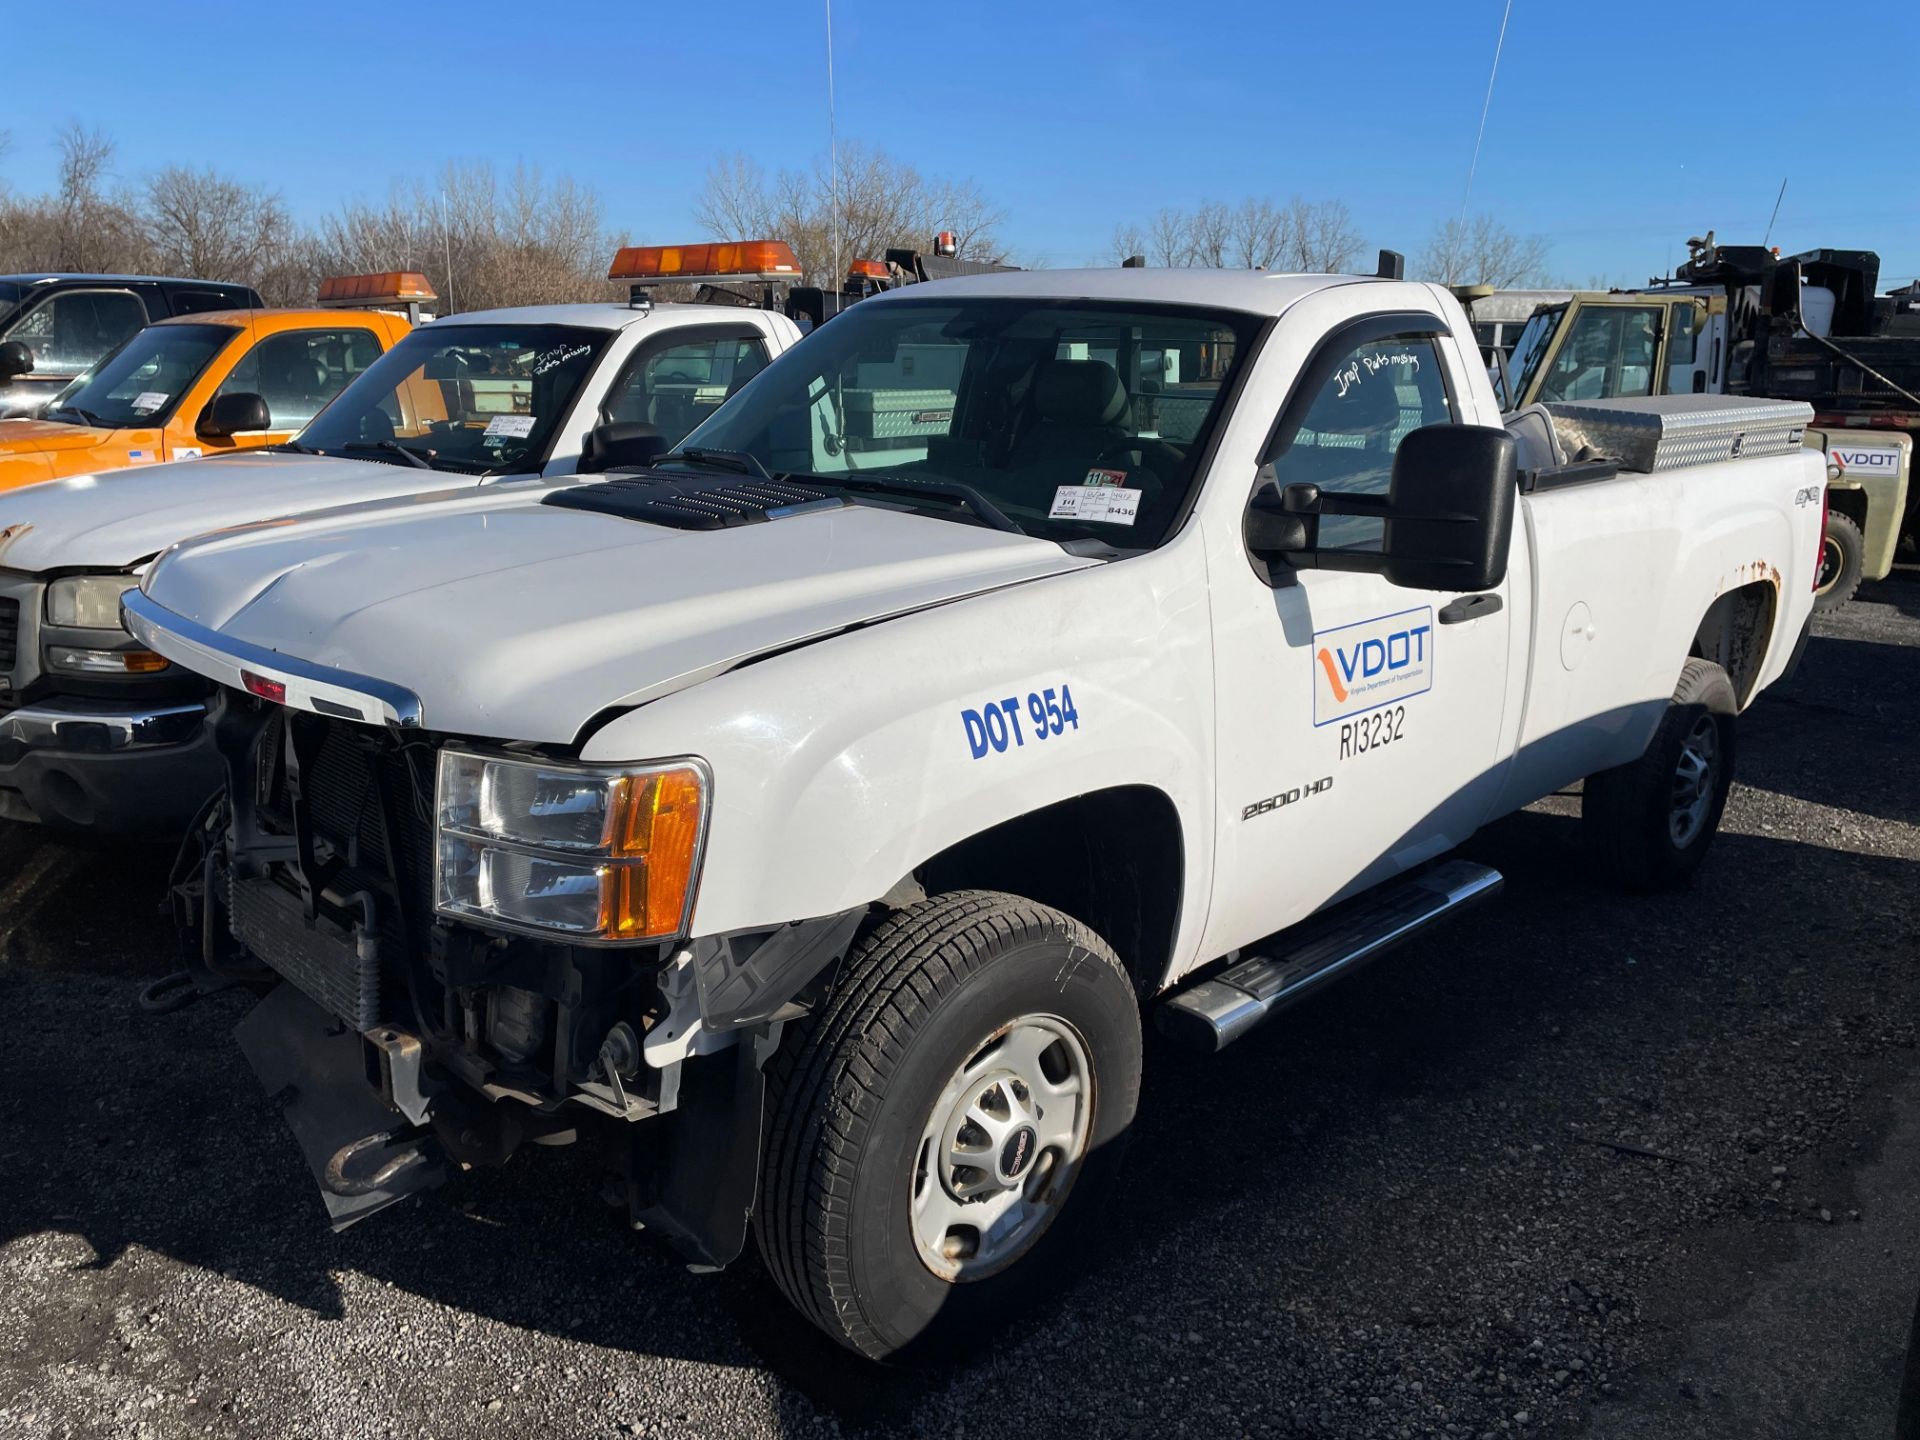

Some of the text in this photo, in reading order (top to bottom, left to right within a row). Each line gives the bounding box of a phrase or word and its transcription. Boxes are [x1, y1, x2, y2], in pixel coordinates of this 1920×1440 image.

[1088, 473, 1101, 484] 11
[1842, 453, 1897, 466] VDOT
[1108, 507, 1135, 516] 8436
[1336, 625, 1430, 683] VDOT
[960, 684, 1079, 760] DOT 954
[1339, 705, 1405, 760] R13232
[1241, 776, 1333, 822] 2500 HD
[1010, 1130, 1028, 1175] GMC
